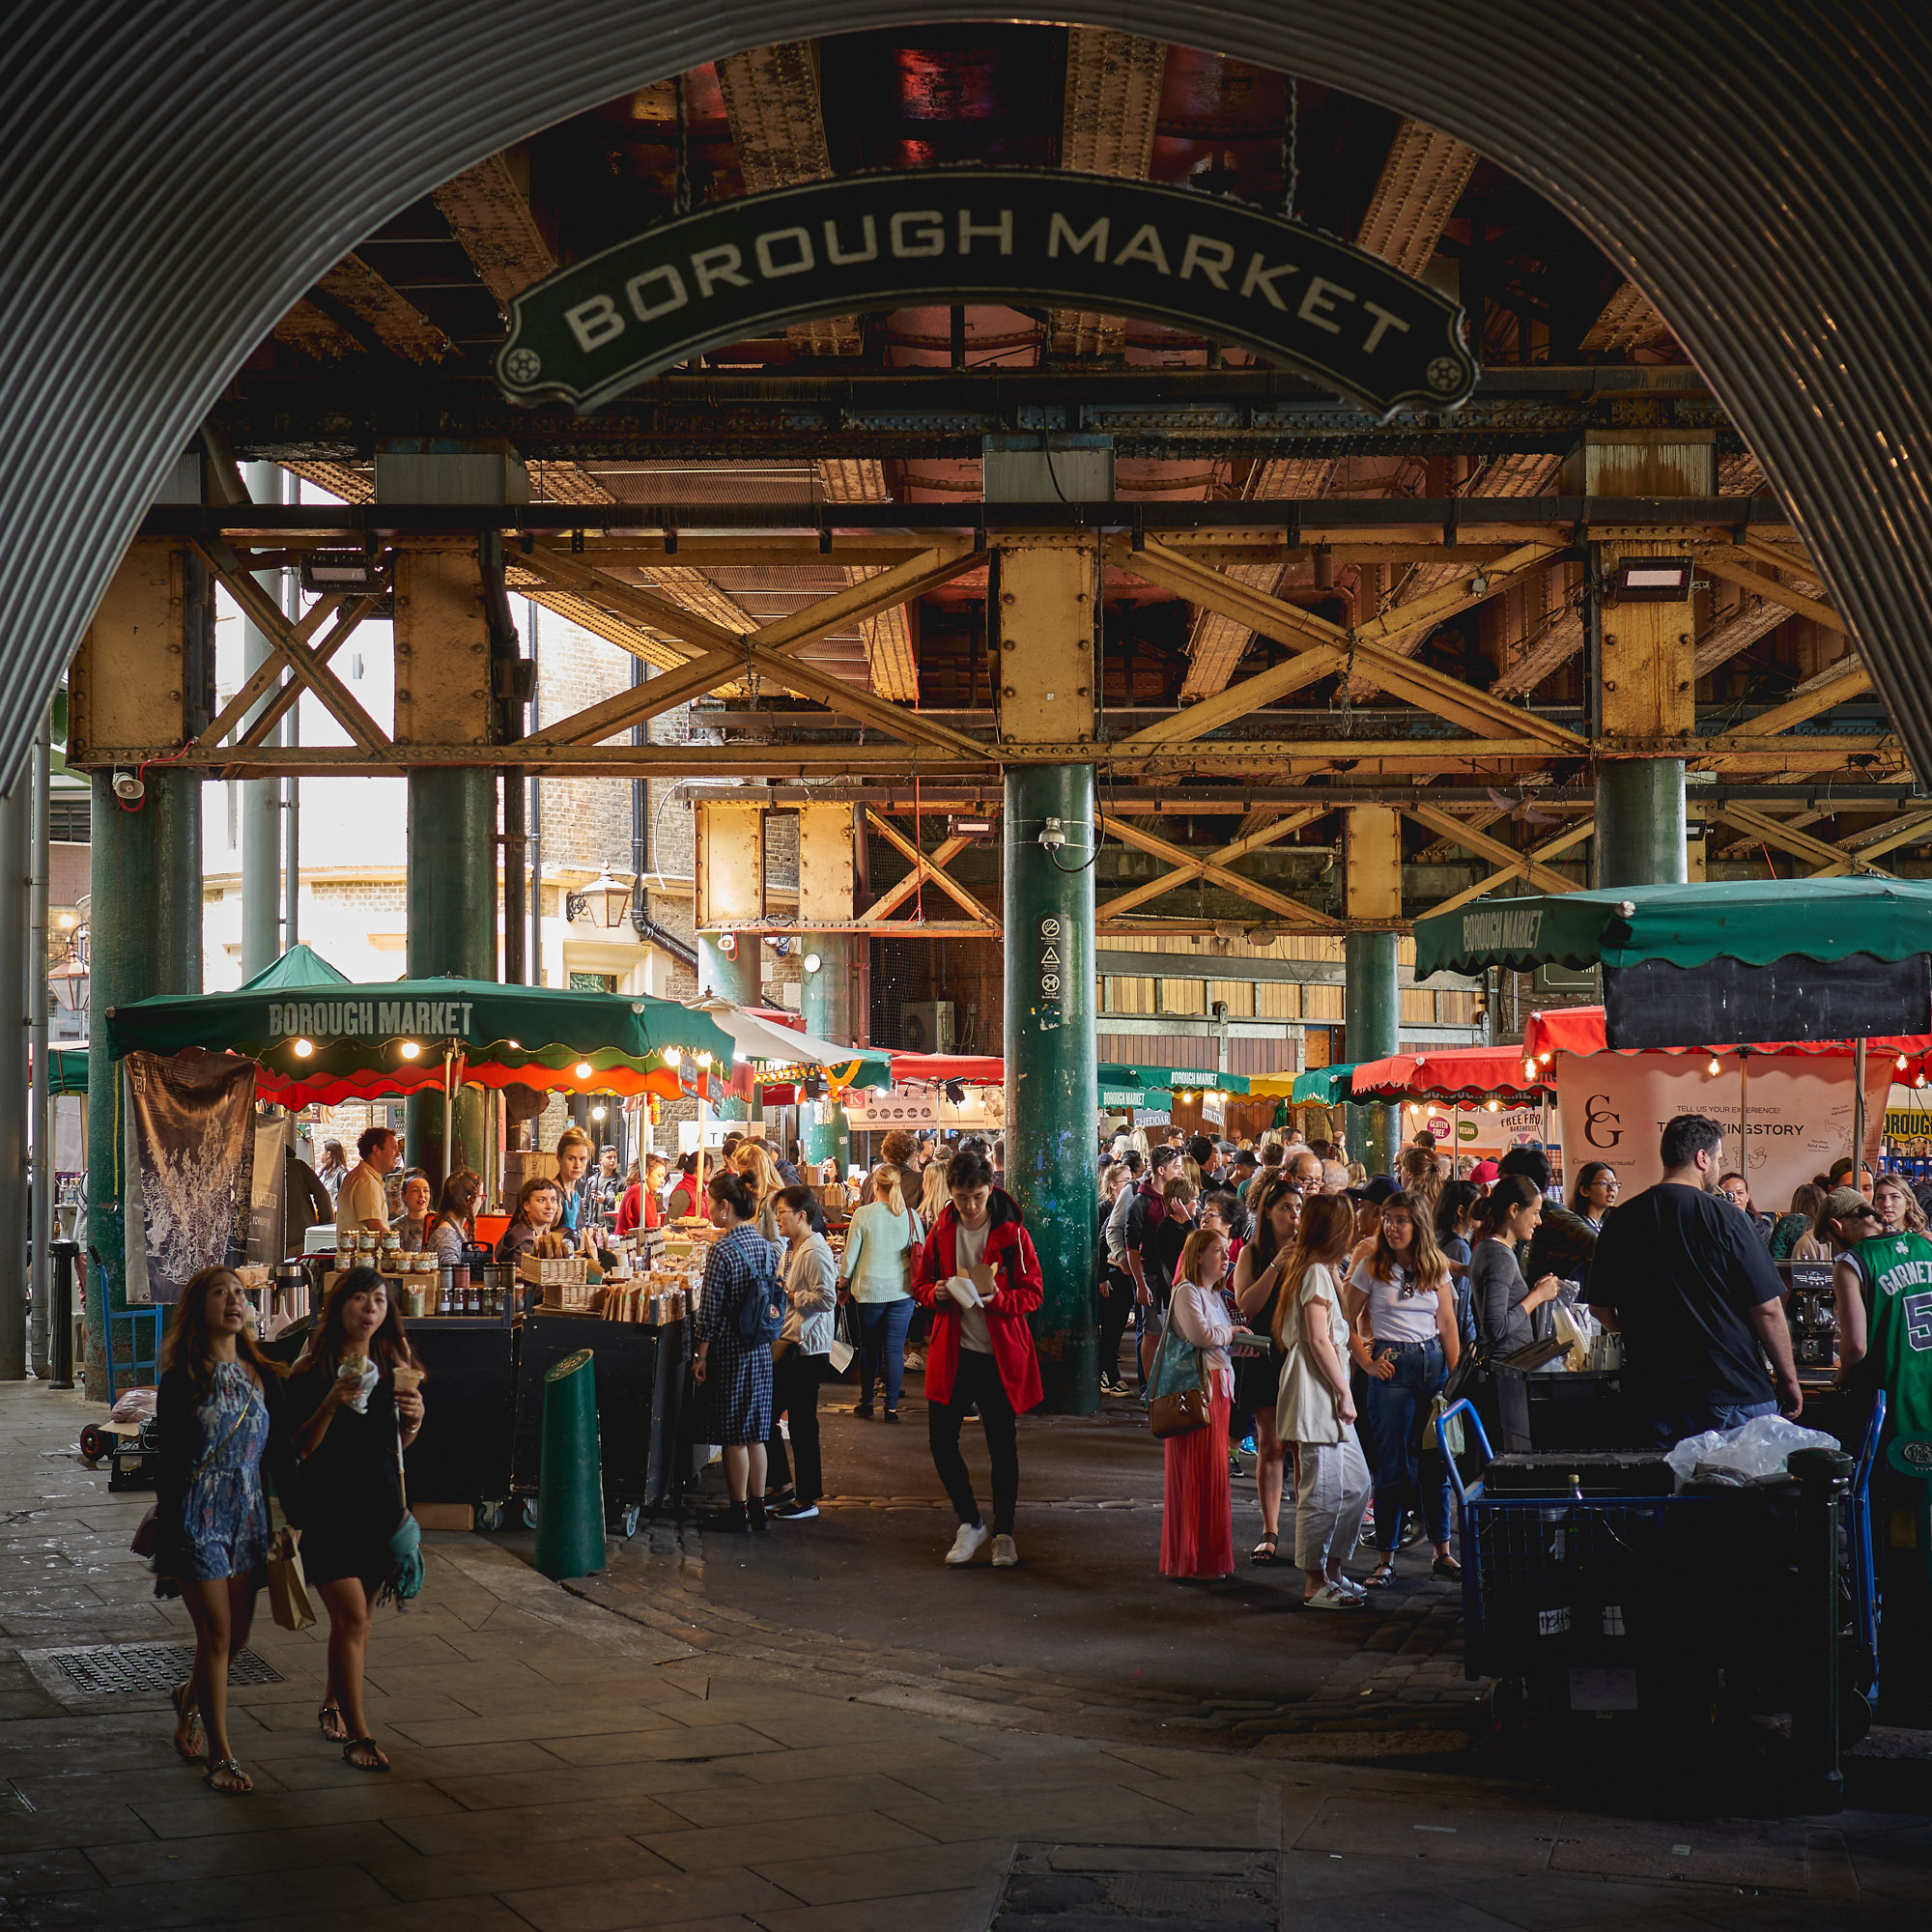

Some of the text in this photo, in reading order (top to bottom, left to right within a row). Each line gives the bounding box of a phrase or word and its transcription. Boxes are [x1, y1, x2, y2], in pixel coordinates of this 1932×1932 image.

[563, 208, 1410, 355] BOROUGH MARKET
[1463, 909, 1544, 952] BOROUGH MARKET
[269, 1002, 473, 1036] BOROUGH MARKET
[1171, 1071, 1218, 1086] BOROUGH MARKET
[1103, 1092, 1145, 1106] BOROUGH MARKET
[1731, 1106, 1780, 1115] EXERIENCE!
[1134, 1116, 1170, 1127] CHEDDAR
[1429, 1120, 1449, 1129] GLUTEN
[1501, 1115, 1524, 1127] FREE
[1433, 1128, 1445, 1138] FREE
[1459, 1125, 1475, 1135] VEGAN
